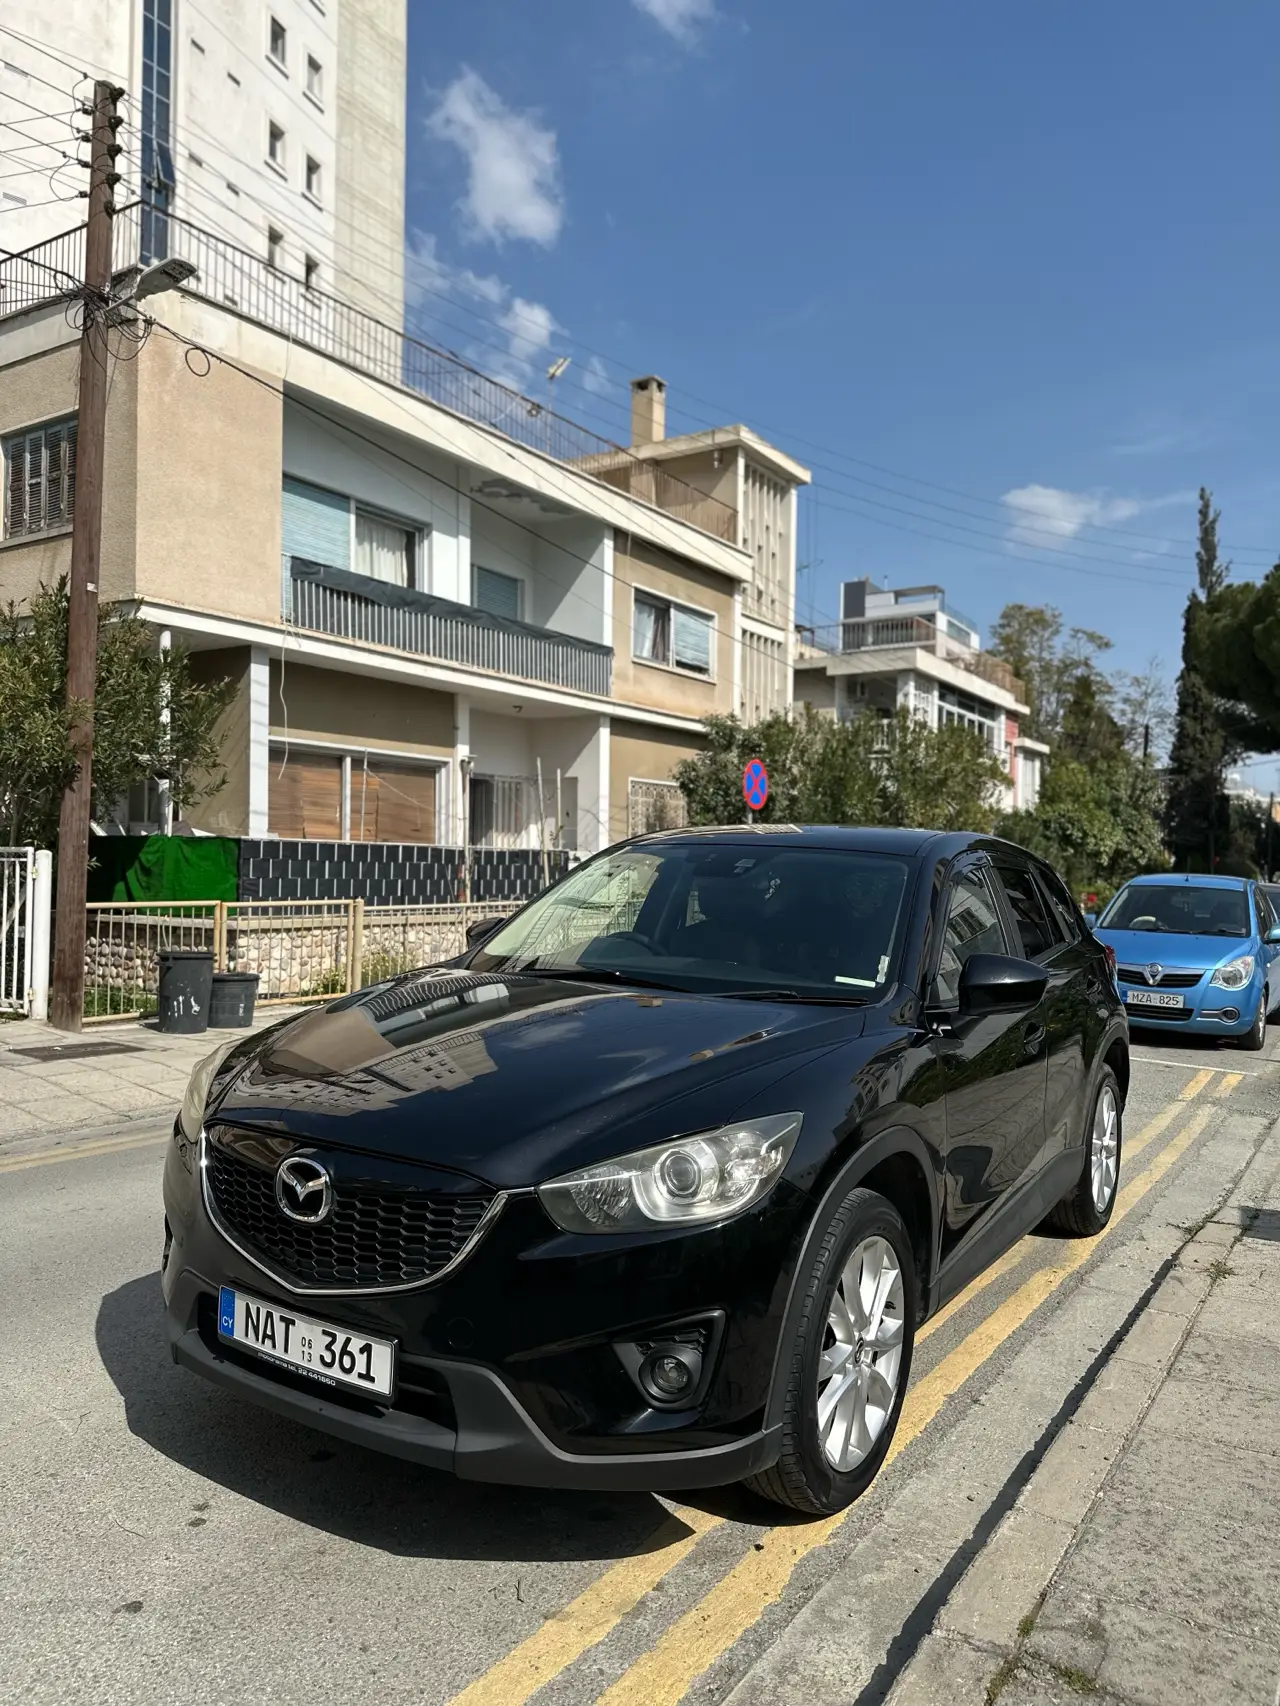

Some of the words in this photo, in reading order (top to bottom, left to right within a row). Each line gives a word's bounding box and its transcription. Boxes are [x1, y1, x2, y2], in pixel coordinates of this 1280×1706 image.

[1132, 992, 1152, 1004] MZA
[1159, 995, 1180, 1006] 825
[222, 1316, 234, 1329] CY
[245, 1302, 296, 1354] NAT
[320, 1329, 376, 1384] 361
[301, 1336, 312, 1349] 06
[301, 1350, 312, 1362] 13
[298, 1367, 308, 1375] 22
